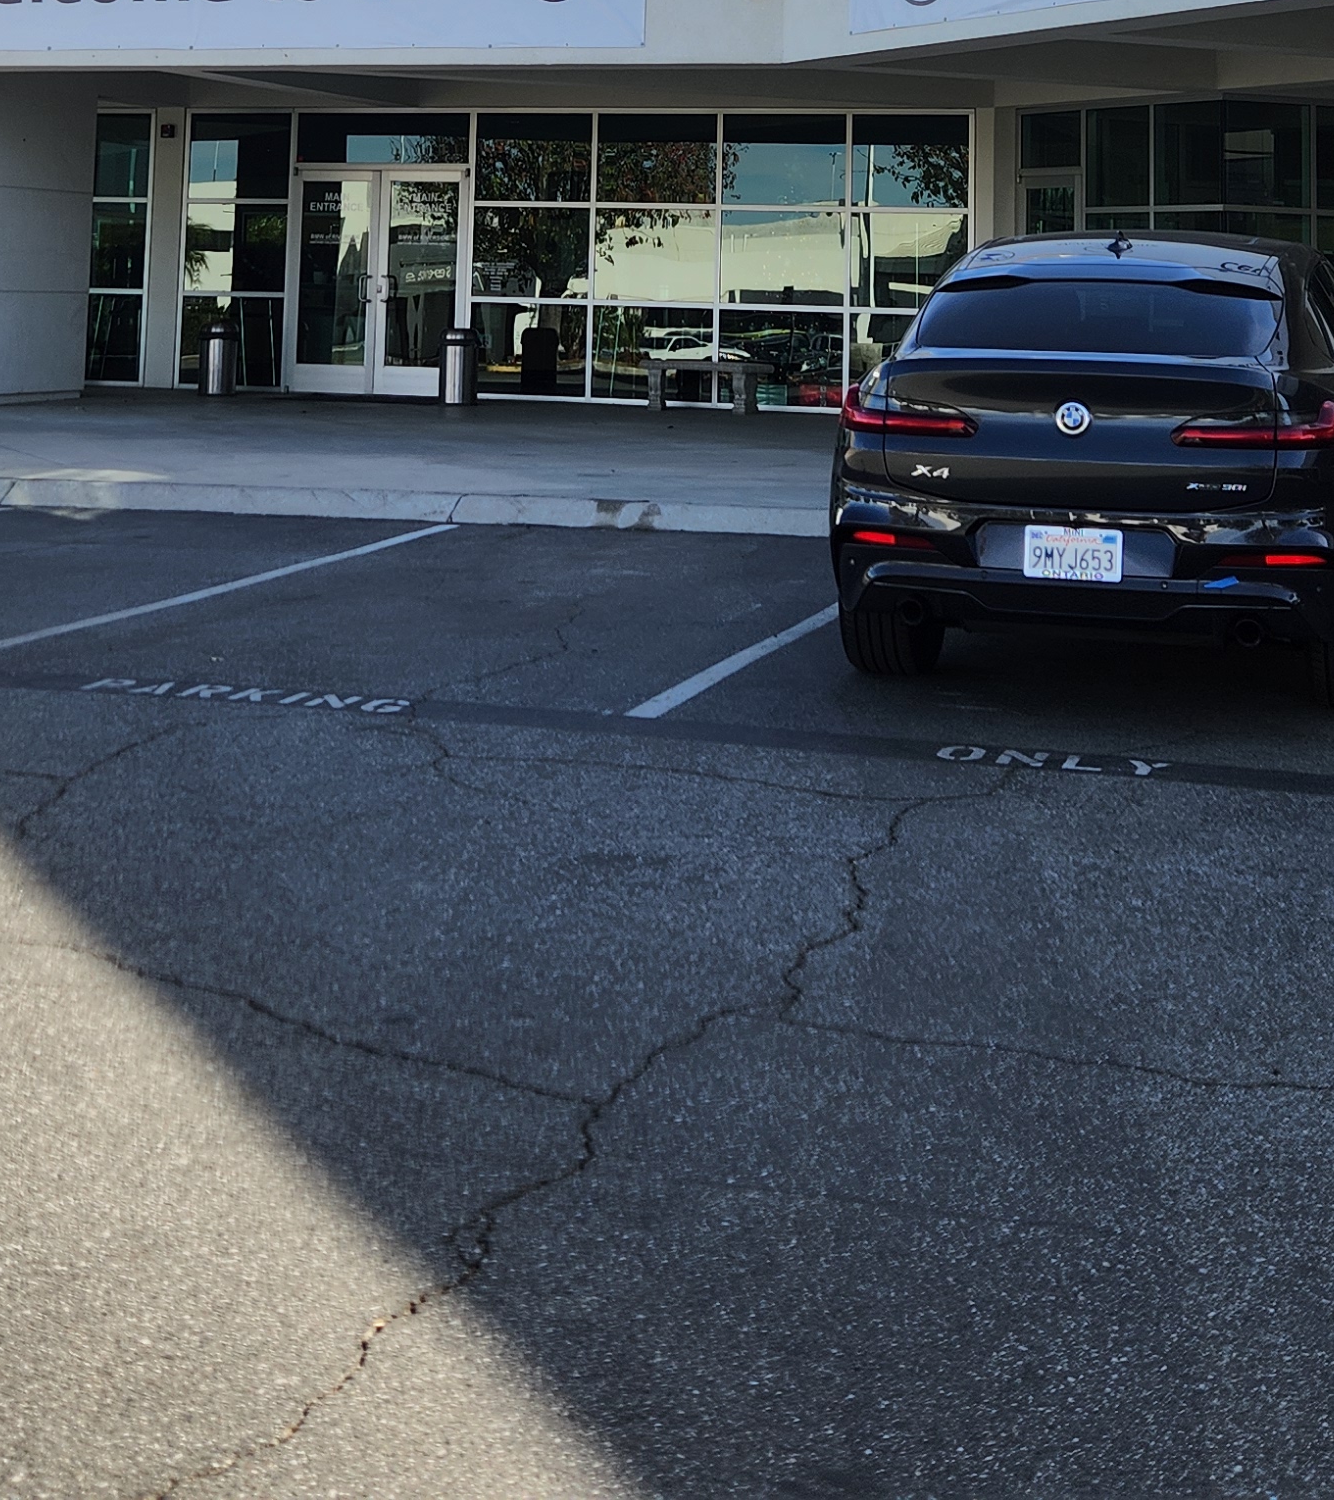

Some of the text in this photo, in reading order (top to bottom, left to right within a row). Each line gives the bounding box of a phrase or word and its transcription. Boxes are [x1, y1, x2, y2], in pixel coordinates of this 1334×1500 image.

[324, 192, 350, 201] MAIN
[412, 192, 439, 202] MAIN
[309, 202, 364, 212] ENTRANCE
[398, 202, 452, 213] ENTRANCE
[910, 464, 950, 479] X4
[1063, 528, 1084, 537] MINI
[1045, 534, 1104, 547] California
[1031, 545, 1114, 572] 9MYJ653
[1041, 568, 1104, 580] ONTARIO
[79, 677, 411, 714] PARKING
[935, 745, 1173, 776] ONLY
